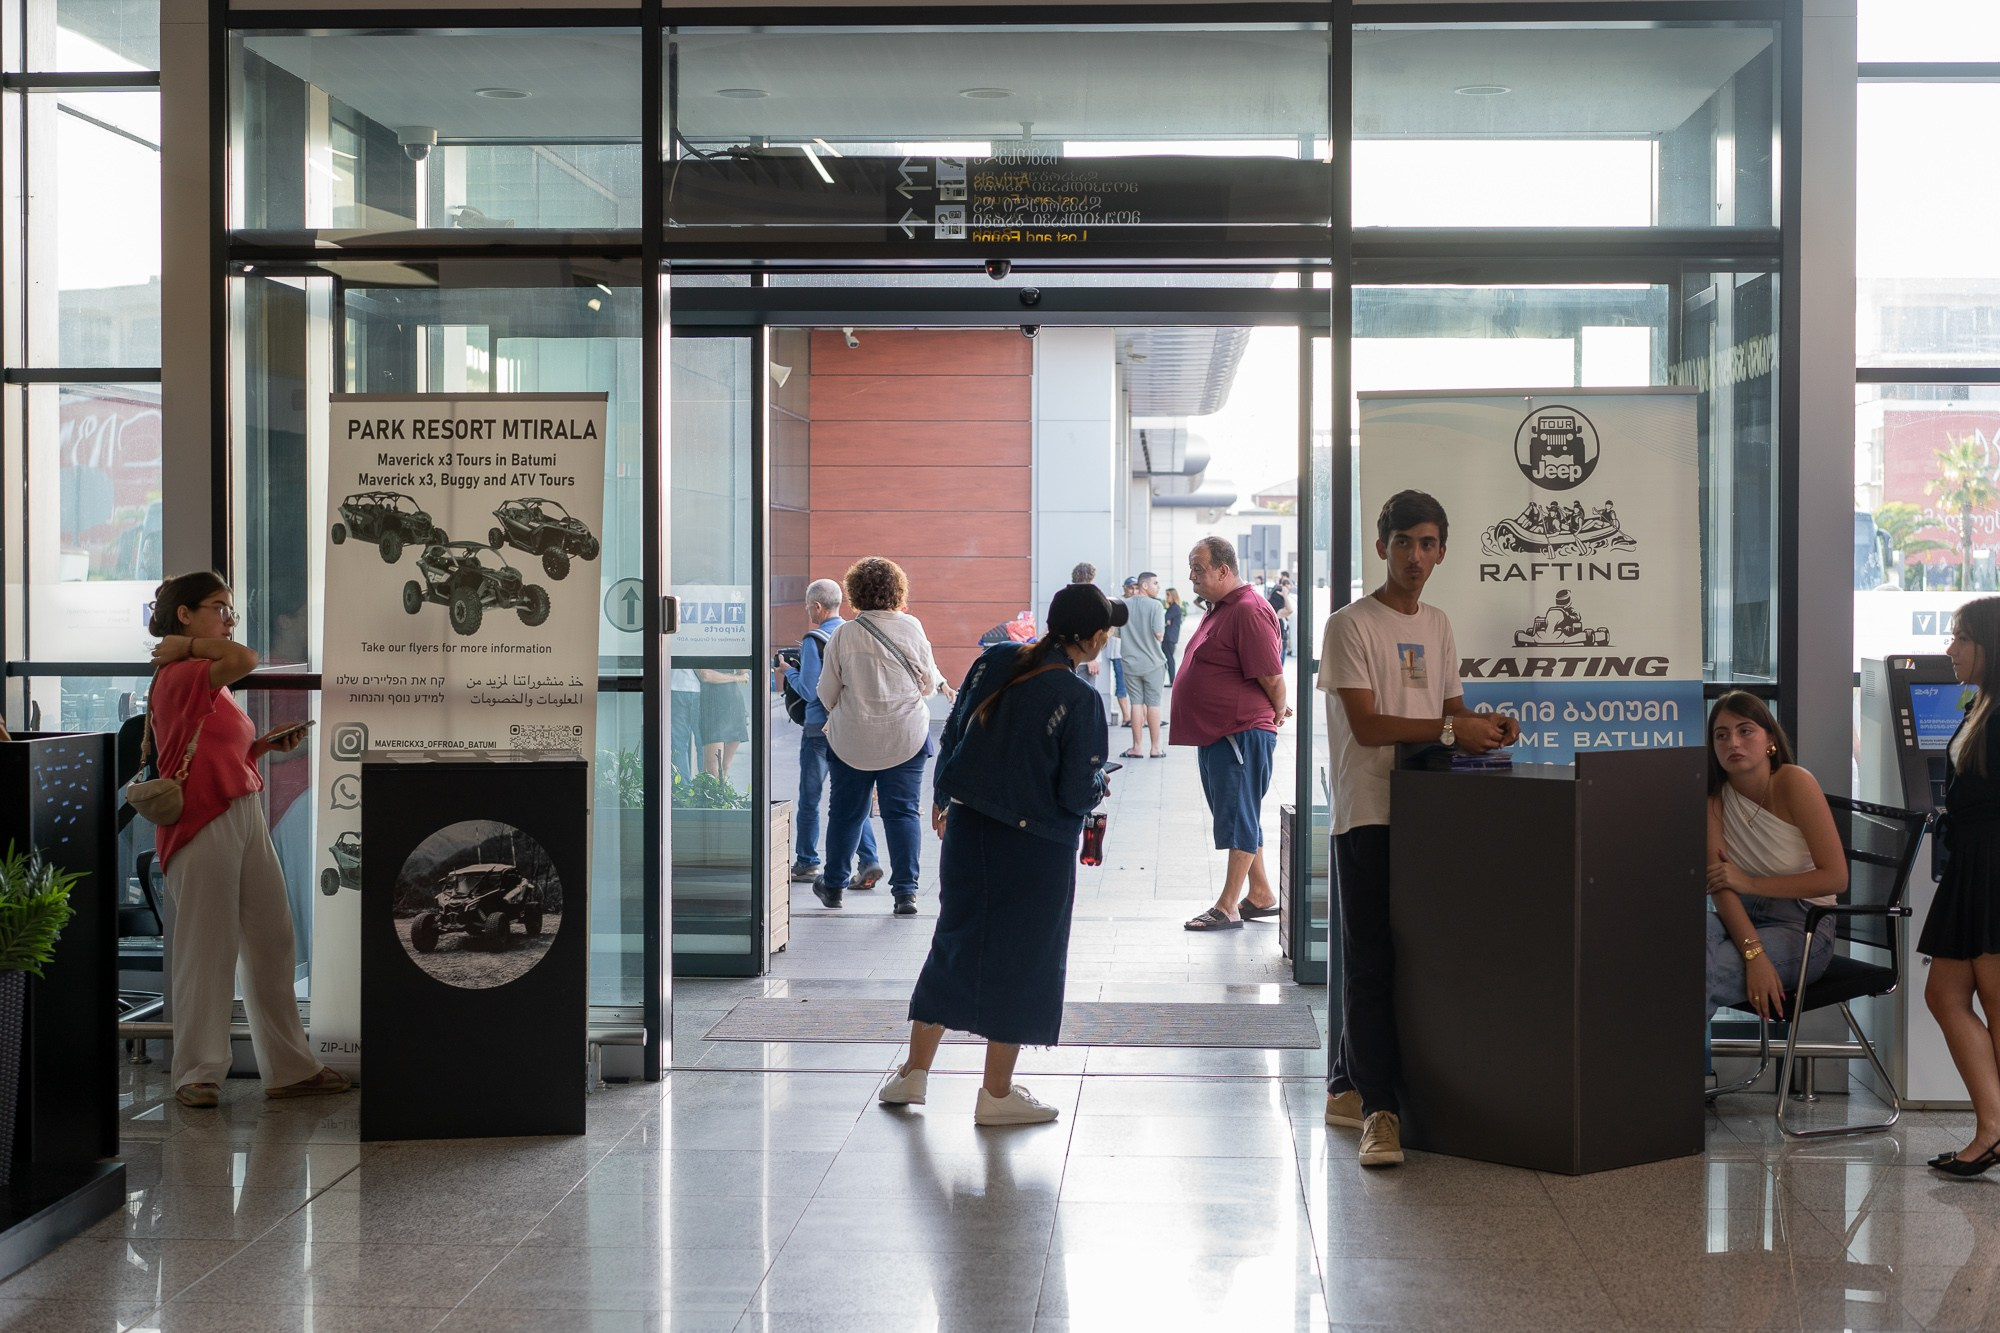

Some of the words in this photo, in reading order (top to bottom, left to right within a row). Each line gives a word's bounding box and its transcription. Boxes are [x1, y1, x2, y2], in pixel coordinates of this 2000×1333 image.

[348, 419, 406, 440] PARK
[412, 419, 497, 440] RESORT
[502, 419, 598, 440] MTIRALA
[1541, 420, 1573, 429] TOUR
[377, 453, 434, 466] Maverick
[438, 454, 453, 466] x3
[456, 453, 493, 466] Tours
[496, 453, 507, 466] in
[511, 453, 557, 466] Batumi
[1532, 461, 1583, 482] Jeep
[358, 473, 415, 486] Maverick
[419, 474, 437, 488] x3,
[441, 474, 479, 489] Buggy
[484, 474, 507, 486] and
[510, 474, 536, 486] ATV
[539, 474, 575, 487] Tours
[1480, 562, 1640, 582] RAFTING
[361, 642, 386, 653] Take
[388, 644, 406, 653] our
[409, 642, 439, 655] flyers
[442, 642, 458, 653] for
[460, 644, 488, 653] more
[490, 643, 552, 654] information
[1458, 656, 1670, 677] KARTING
[336, 674, 359, 685] שלנו
[411, 676, 427, 686] את
[430, 677, 445, 688] קח
[466, 678, 482, 688] من
[486, 674, 508, 689] لمزيد
[513, 674, 564, 689] منشوراتنا
[568, 676, 584, 687] خذ
[349, 694, 385, 703] והנחות
[388, 694, 411, 705] נוסף
[414, 692, 445, 703] למידע
[470, 693, 533, 707] والخصومات
[536, 693, 583, 707] المعلومات
[1563, 701, 1679, 722] ბათუმი
[375, 740, 497, 749] MAVERICKX3_OFFROAD_BATUMI
[1573, 731, 1684, 748] BATUMI
